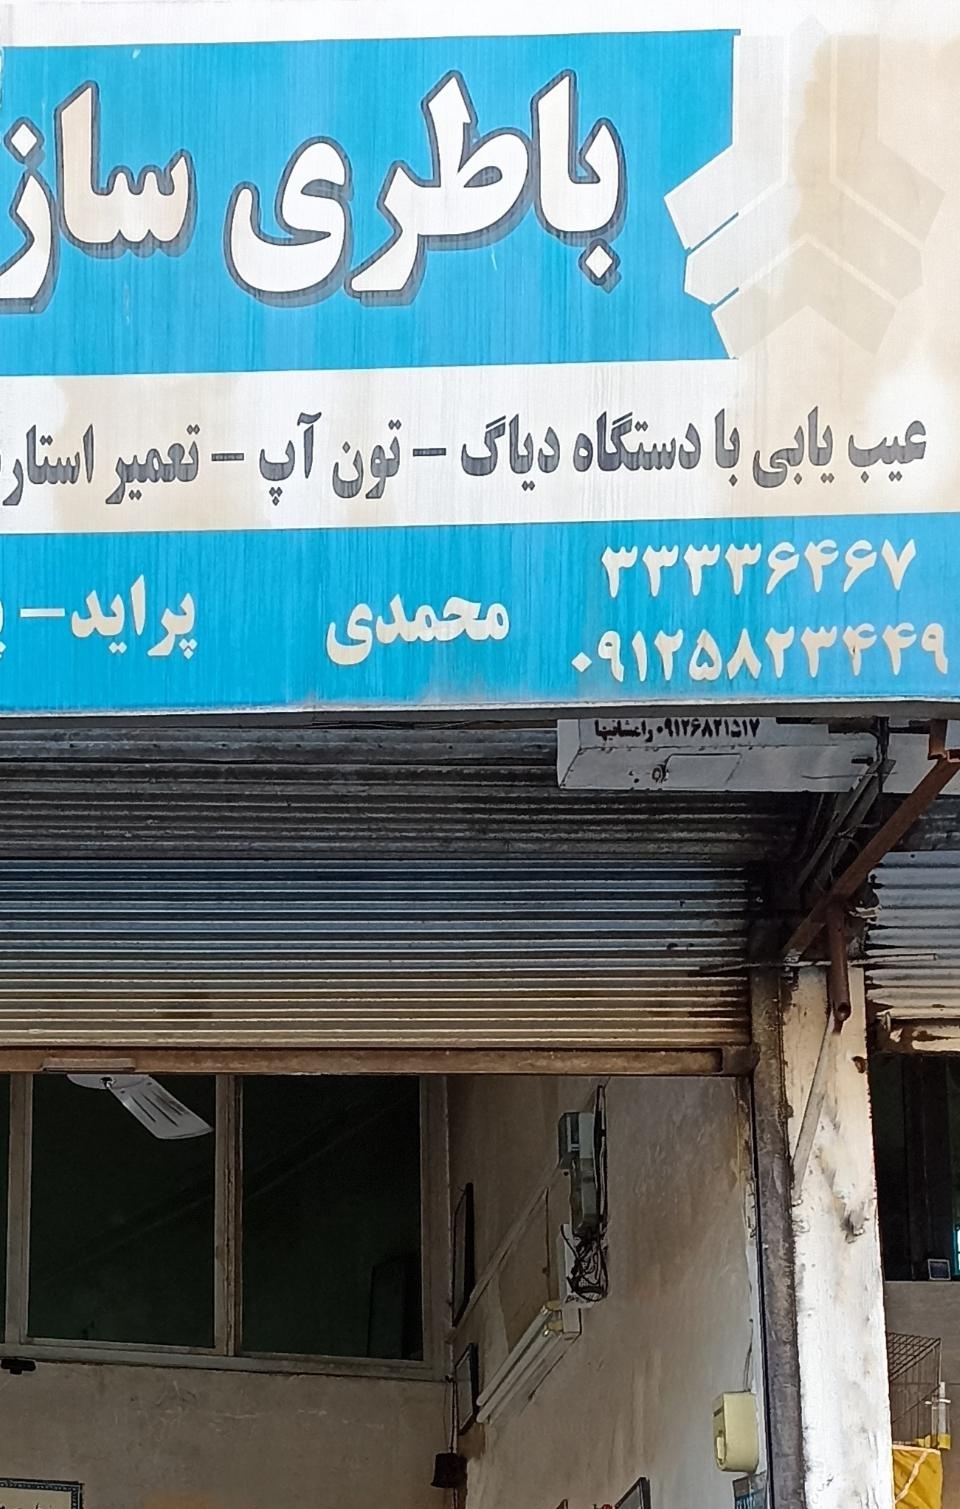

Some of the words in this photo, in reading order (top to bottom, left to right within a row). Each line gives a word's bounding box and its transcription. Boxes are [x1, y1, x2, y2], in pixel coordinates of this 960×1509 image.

[226, 70, 622, 305] باطری
[105, 423, 202, 506] تعمیر
[259, 411, 323, 507] آپ
[332, 419, 403, 501] تون
[460, 413, 562, 492] دیاگ
[573, 411, 702, 473] دستگاه
[713, 408, 741, 488] با
[751, 406, 834, 490] یابی
[846, 419, 928, 484] عیب
[601, 538, 918, 599] ۳۳۳۳۶۴۶۷
[71, 575, 198, 660] پراید
[326, 593, 511, 667] محمدی
[571, 621, 950, 683] ۰۹۱۲۵۸۲۳۴۴۹
